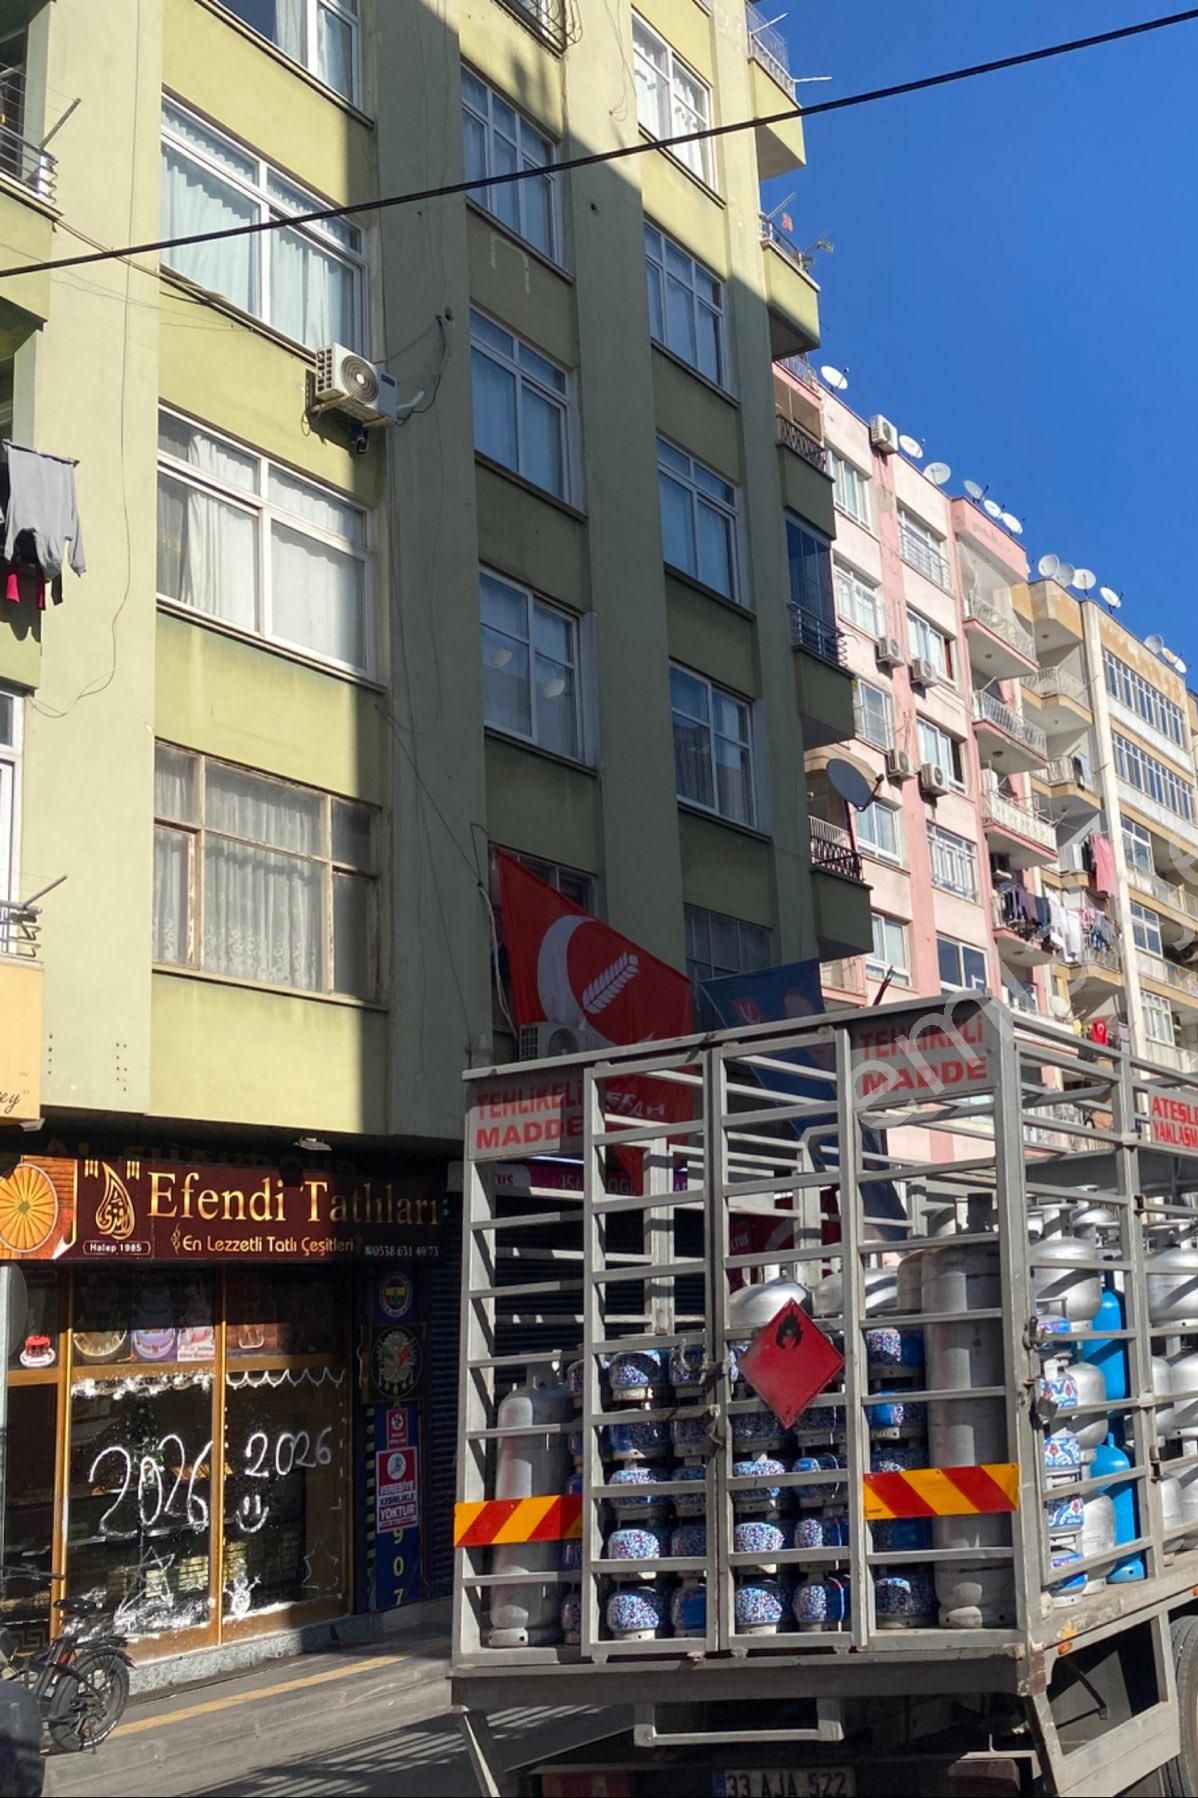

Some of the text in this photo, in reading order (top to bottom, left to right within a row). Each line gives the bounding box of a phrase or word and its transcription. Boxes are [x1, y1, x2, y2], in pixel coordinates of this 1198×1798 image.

[862, 1056, 988, 1096] MADDE
[476, 1115, 584, 1149] MADDE
[147, 1171, 440, 1226] Efendi Tatlıları
[90, 1243, 143, 1254] Halep 1985
[182, 1235, 355, 1257] En Lezzetli Tatlı Çeşitleri
[243, 1426, 333, 1478] 2026
[88, 1433, 214, 1536] 2026
[380, 1503, 416, 1522] YOKTUR
[727, 1771, 846, 1797] 33 AJA 522
